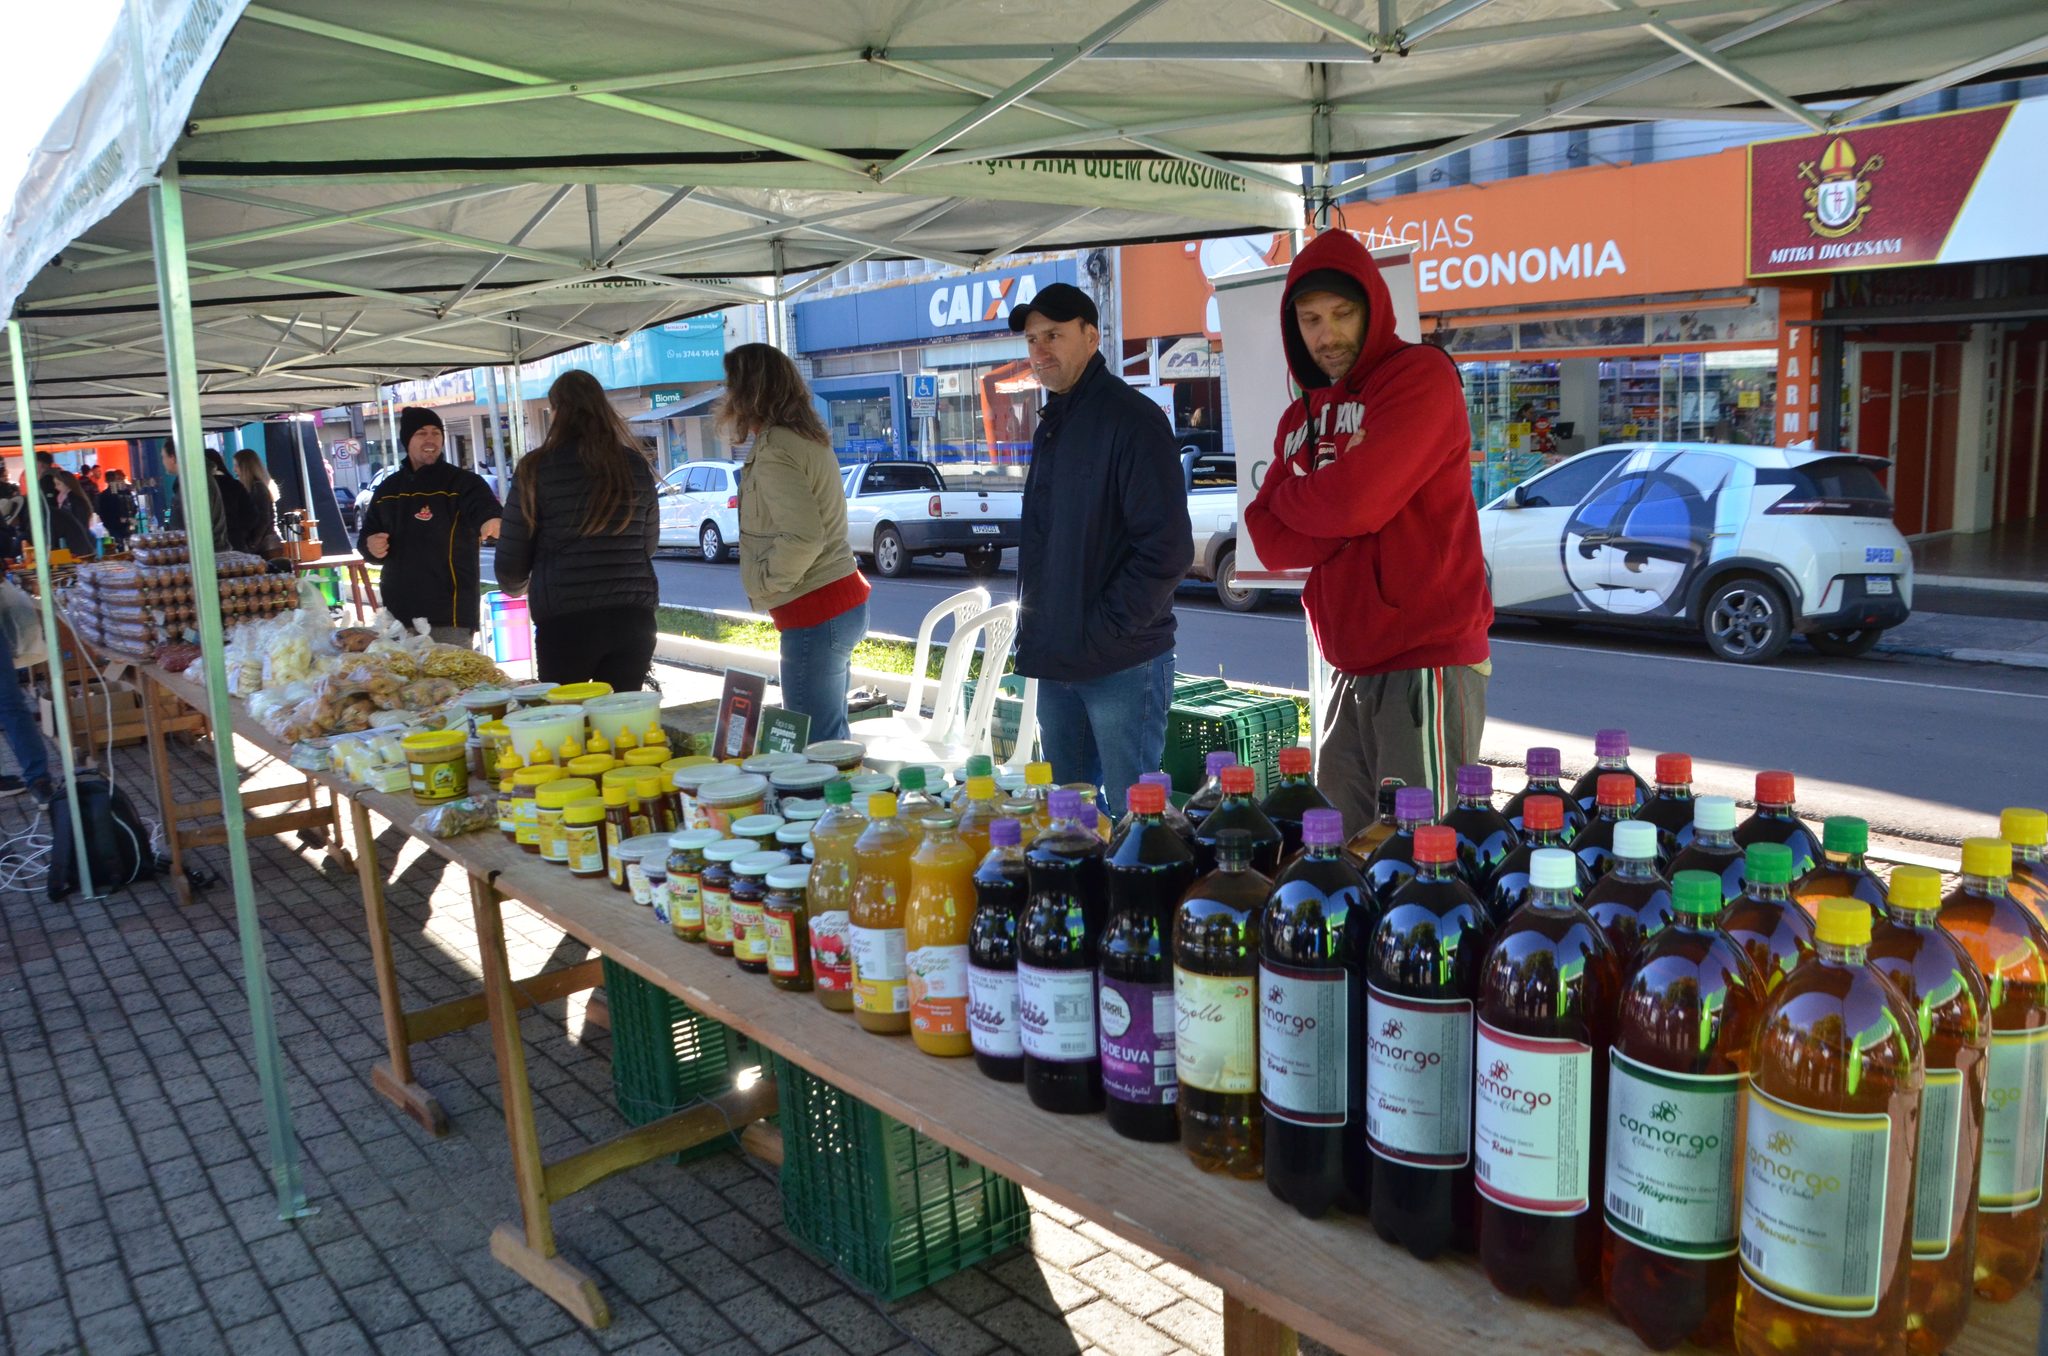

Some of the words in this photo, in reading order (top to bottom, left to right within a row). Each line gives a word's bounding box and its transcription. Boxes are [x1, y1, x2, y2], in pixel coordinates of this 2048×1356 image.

[1419, 239, 1627, 293] ECONOMIA
[1768, 249, 1815, 265] MITRA
[1818, 237, 1903, 260] DIOCESANA
[929, 274, 1037, 327] CAIXA
[683, 350, 700, 358] 3744
[701, 349, 720, 357] 7644
[1782, 328, 1801, 449] FARM
[1109, 1042, 1121, 1058] DE
[1122, 1048, 1150, 1064] UVA
[1619, 1113, 1719, 1154] camargo
[1749, 1145, 1841, 1196] amargo
[1637, 1180, 1689, 1206] Niágara
